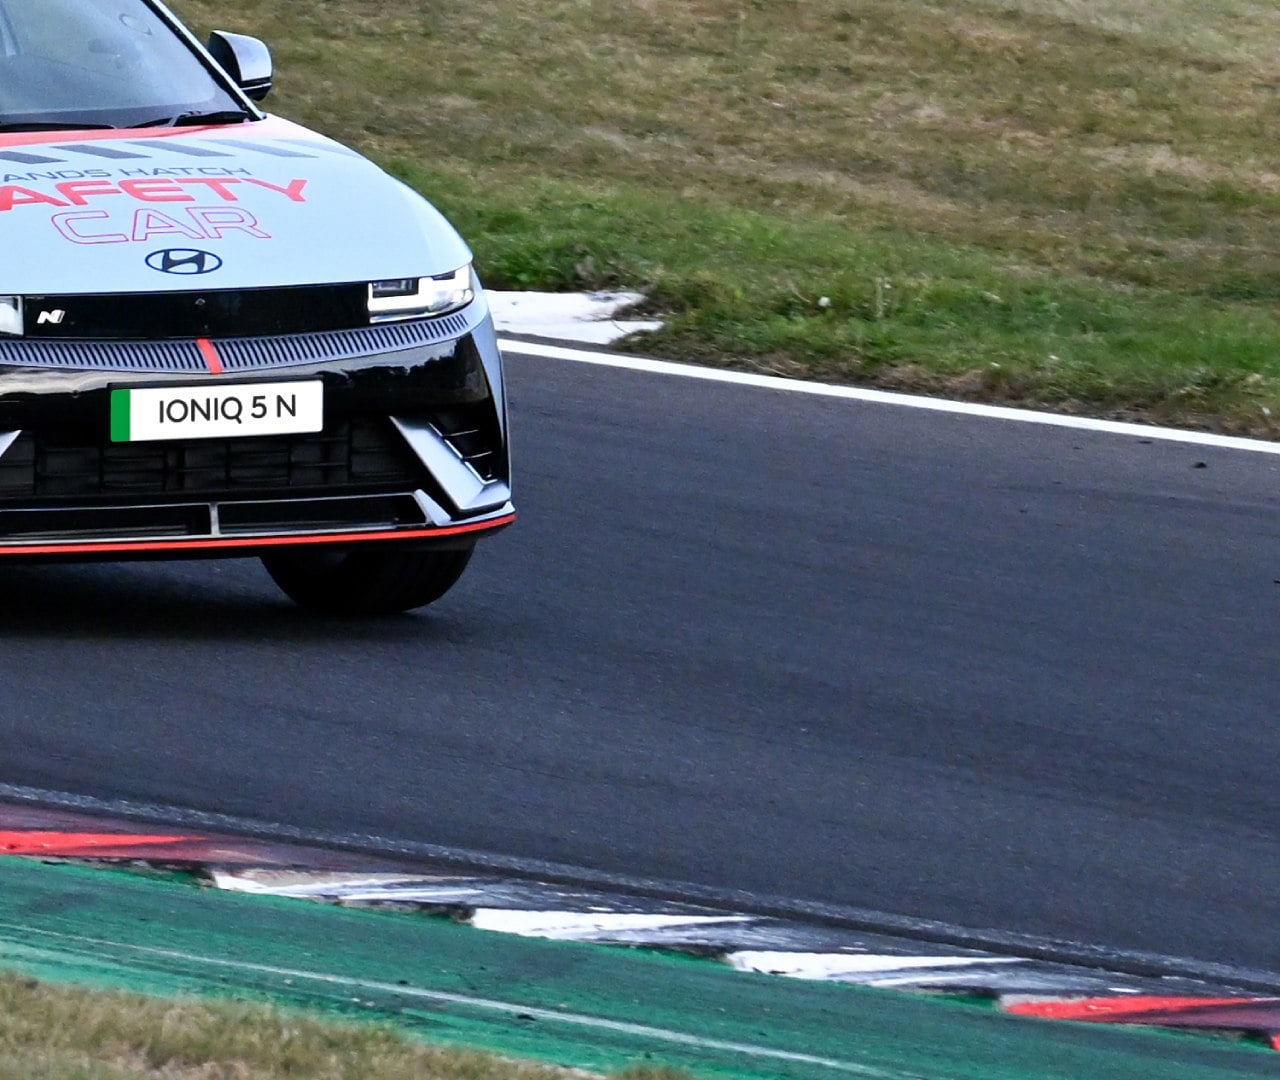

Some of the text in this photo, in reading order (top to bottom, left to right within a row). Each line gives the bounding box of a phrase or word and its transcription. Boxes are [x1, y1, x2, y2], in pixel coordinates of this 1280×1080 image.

[119, 166, 248, 177] HATCH
[50, 205, 272, 245] CAR
[158, 393, 297, 425] IONIQ 5 N
